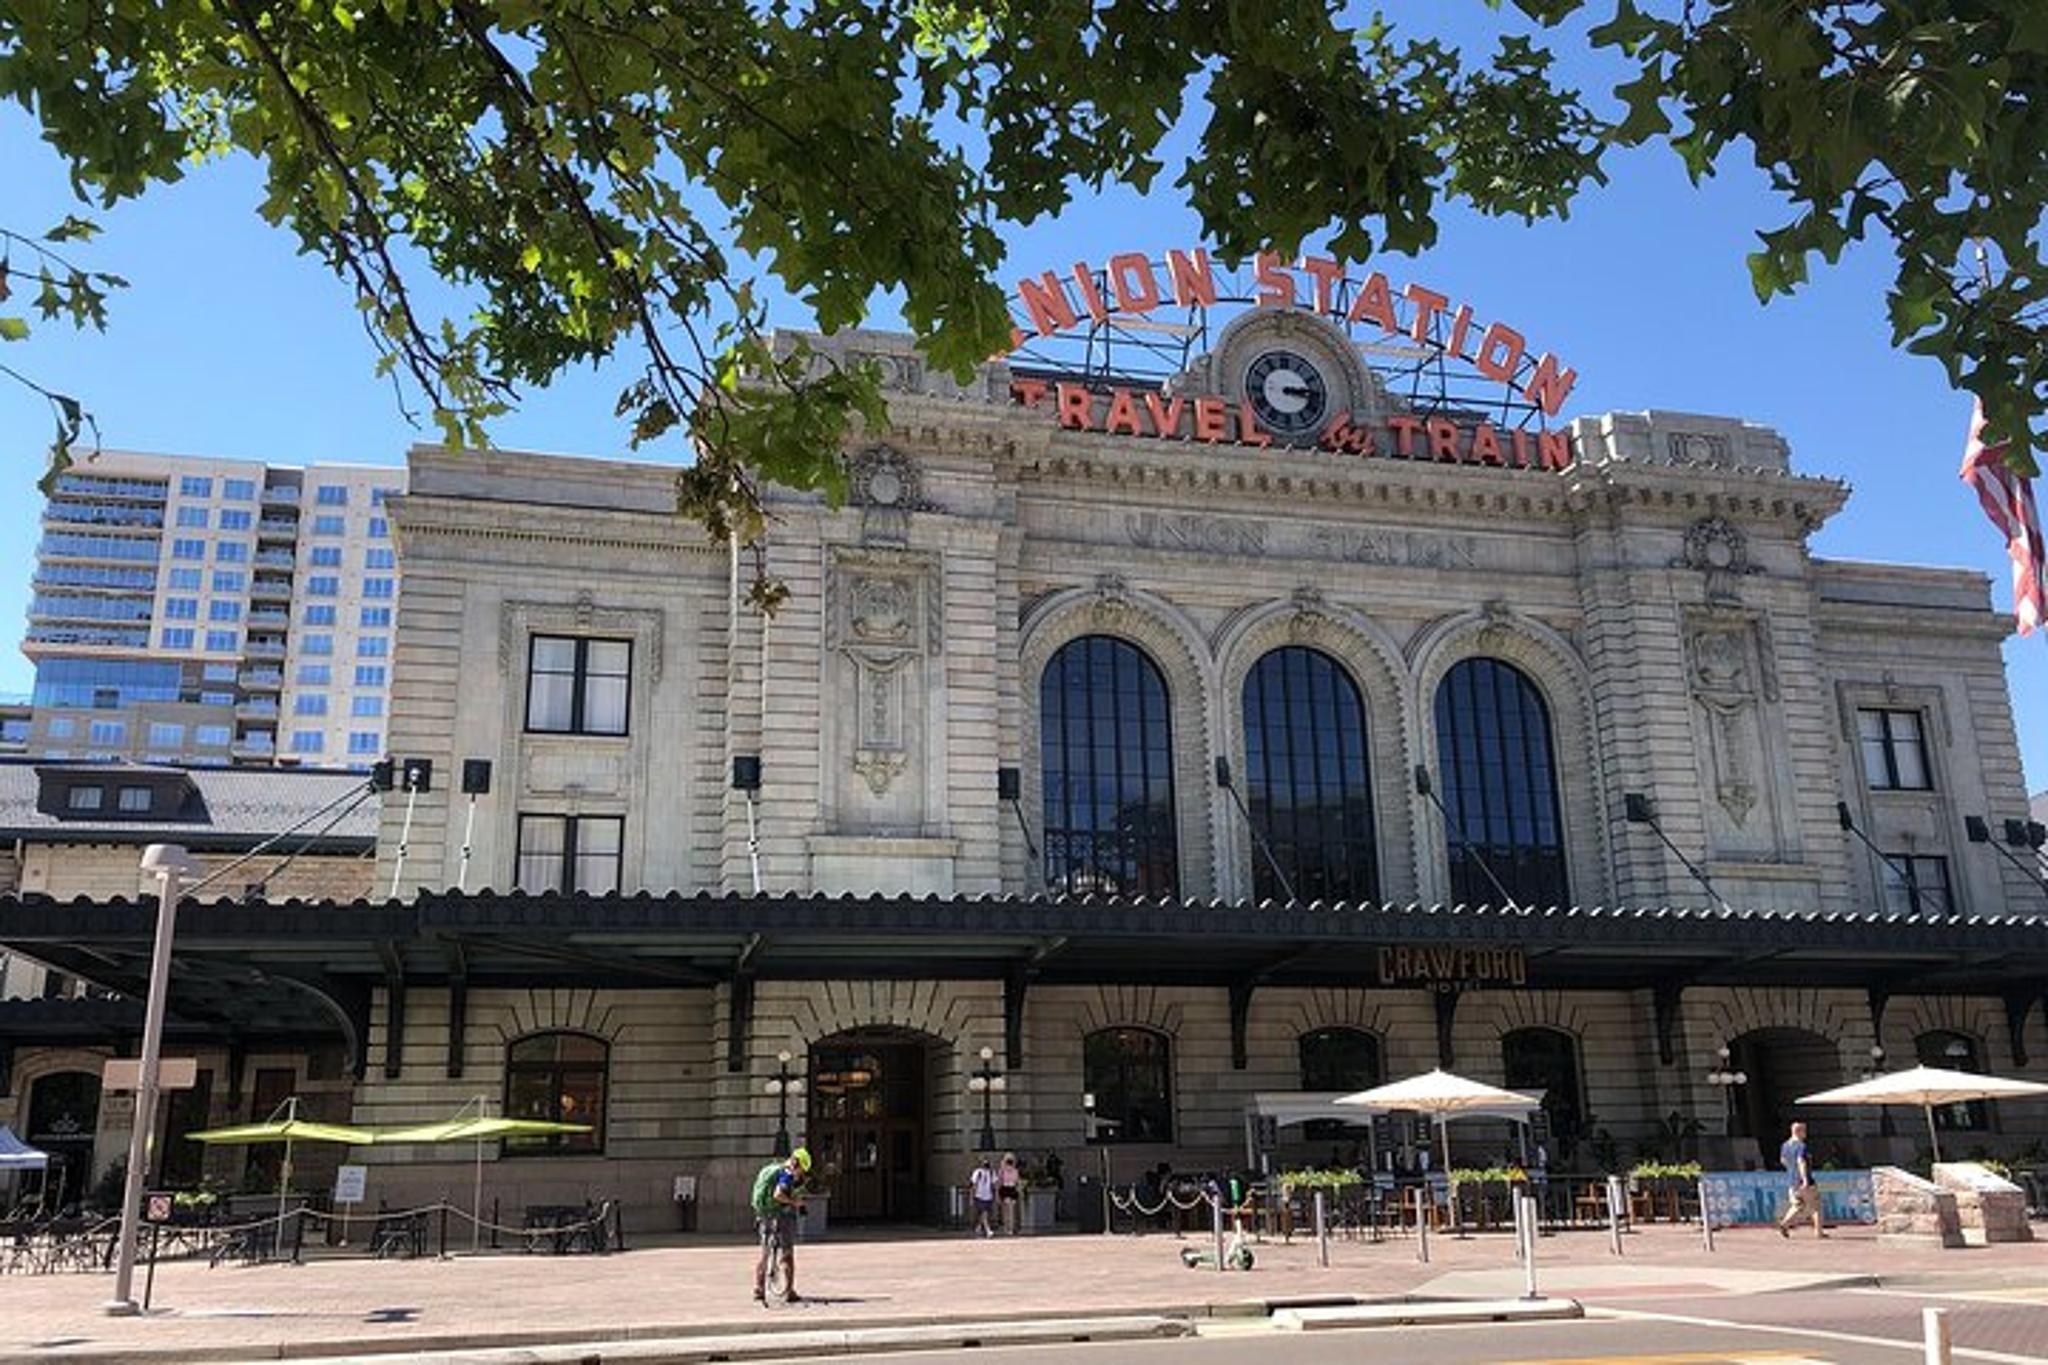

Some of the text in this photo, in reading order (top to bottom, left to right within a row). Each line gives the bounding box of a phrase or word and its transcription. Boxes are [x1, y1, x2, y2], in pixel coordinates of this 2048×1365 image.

[1006, 248, 1217, 352] NION
[1254, 250, 1577, 416] STATION
[1009, 378, 1273, 443] TRAVEL
[1322, 410, 1376, 455] by
[1388, 415, 1574, 471] TRAIN
[1124, 510, 1269, 555] UNION
[1379, 946, 1527, 985] CRAWFORD
